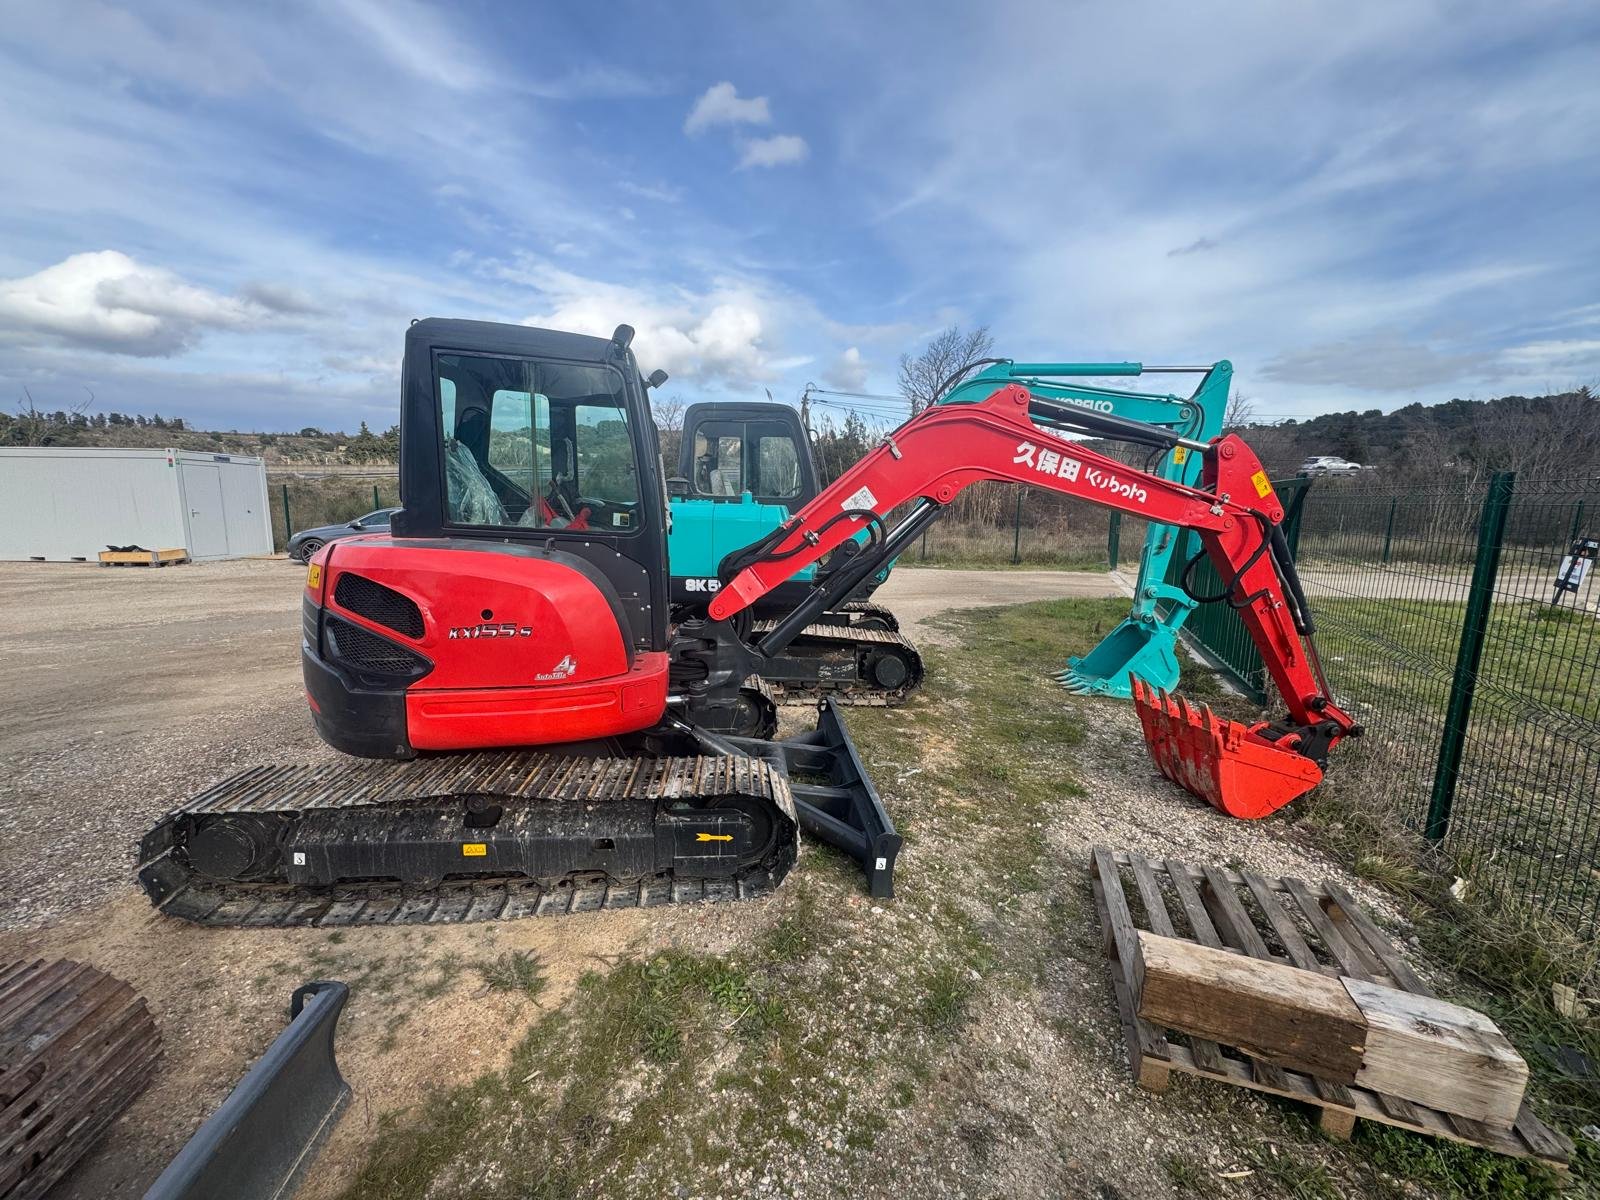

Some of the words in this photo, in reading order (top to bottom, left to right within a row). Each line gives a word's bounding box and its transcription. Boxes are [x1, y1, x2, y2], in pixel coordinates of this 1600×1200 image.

[1013, 441, 1082, 482] 久保田
[1085, 467, 1147, 503] Kubota
